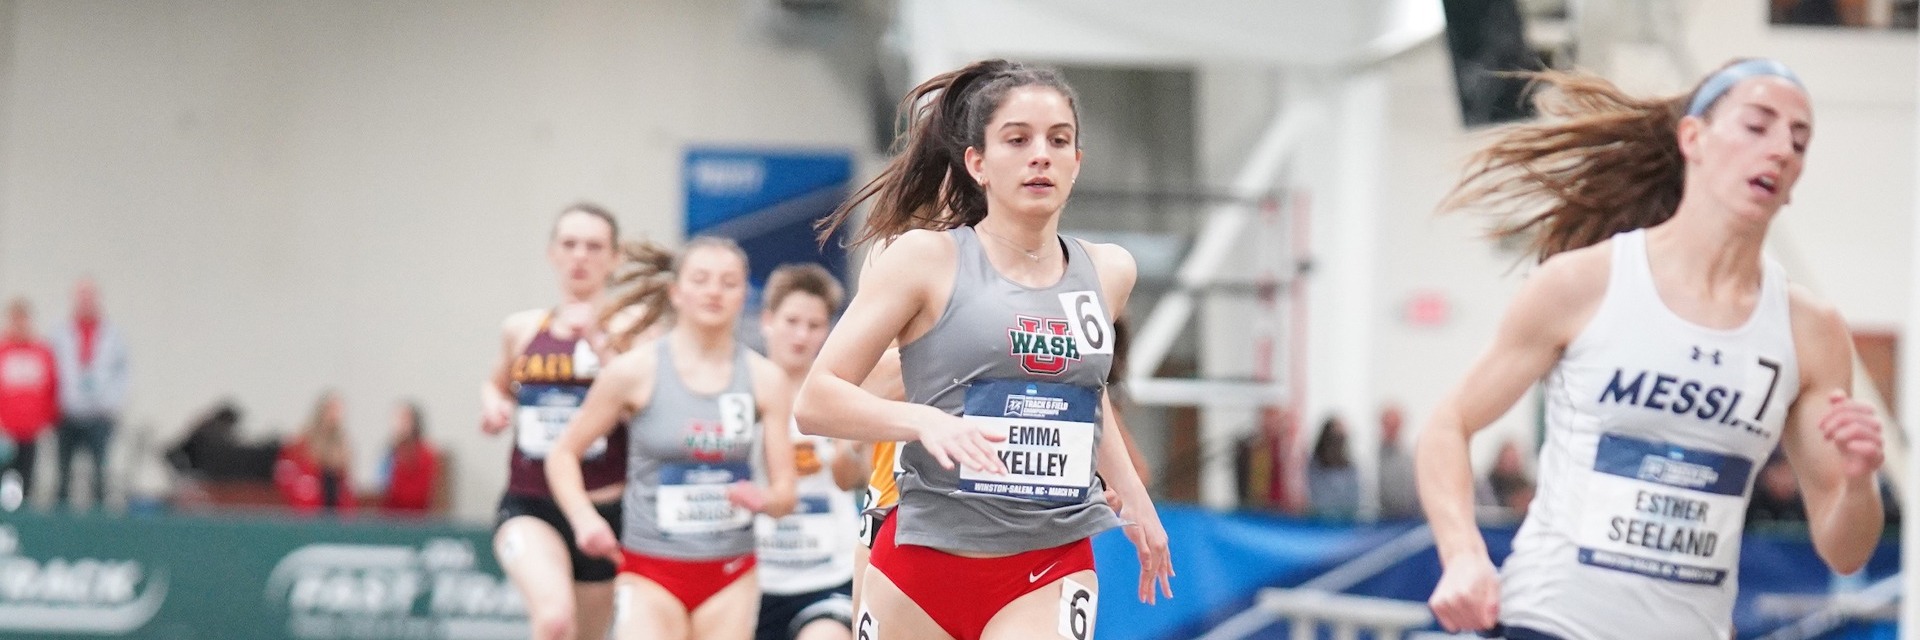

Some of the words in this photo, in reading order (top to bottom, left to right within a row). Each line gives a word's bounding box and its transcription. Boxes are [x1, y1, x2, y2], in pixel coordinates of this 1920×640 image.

[1075, 294, 1104, 350] 6
[1009, 330, 1081, 360] WASH
[1598, 367, 1771, 438] MESSI
[1755, 356, 1783, 422] 7
[733, 397, 746, 435] 3
[1008, 425, 1061, 447] EMMA
[1636, 490, 1710, 523] ESTHER
[1608, 516, 1719, 558] SEELAND
[1069, 589, 1090, 640] 6
